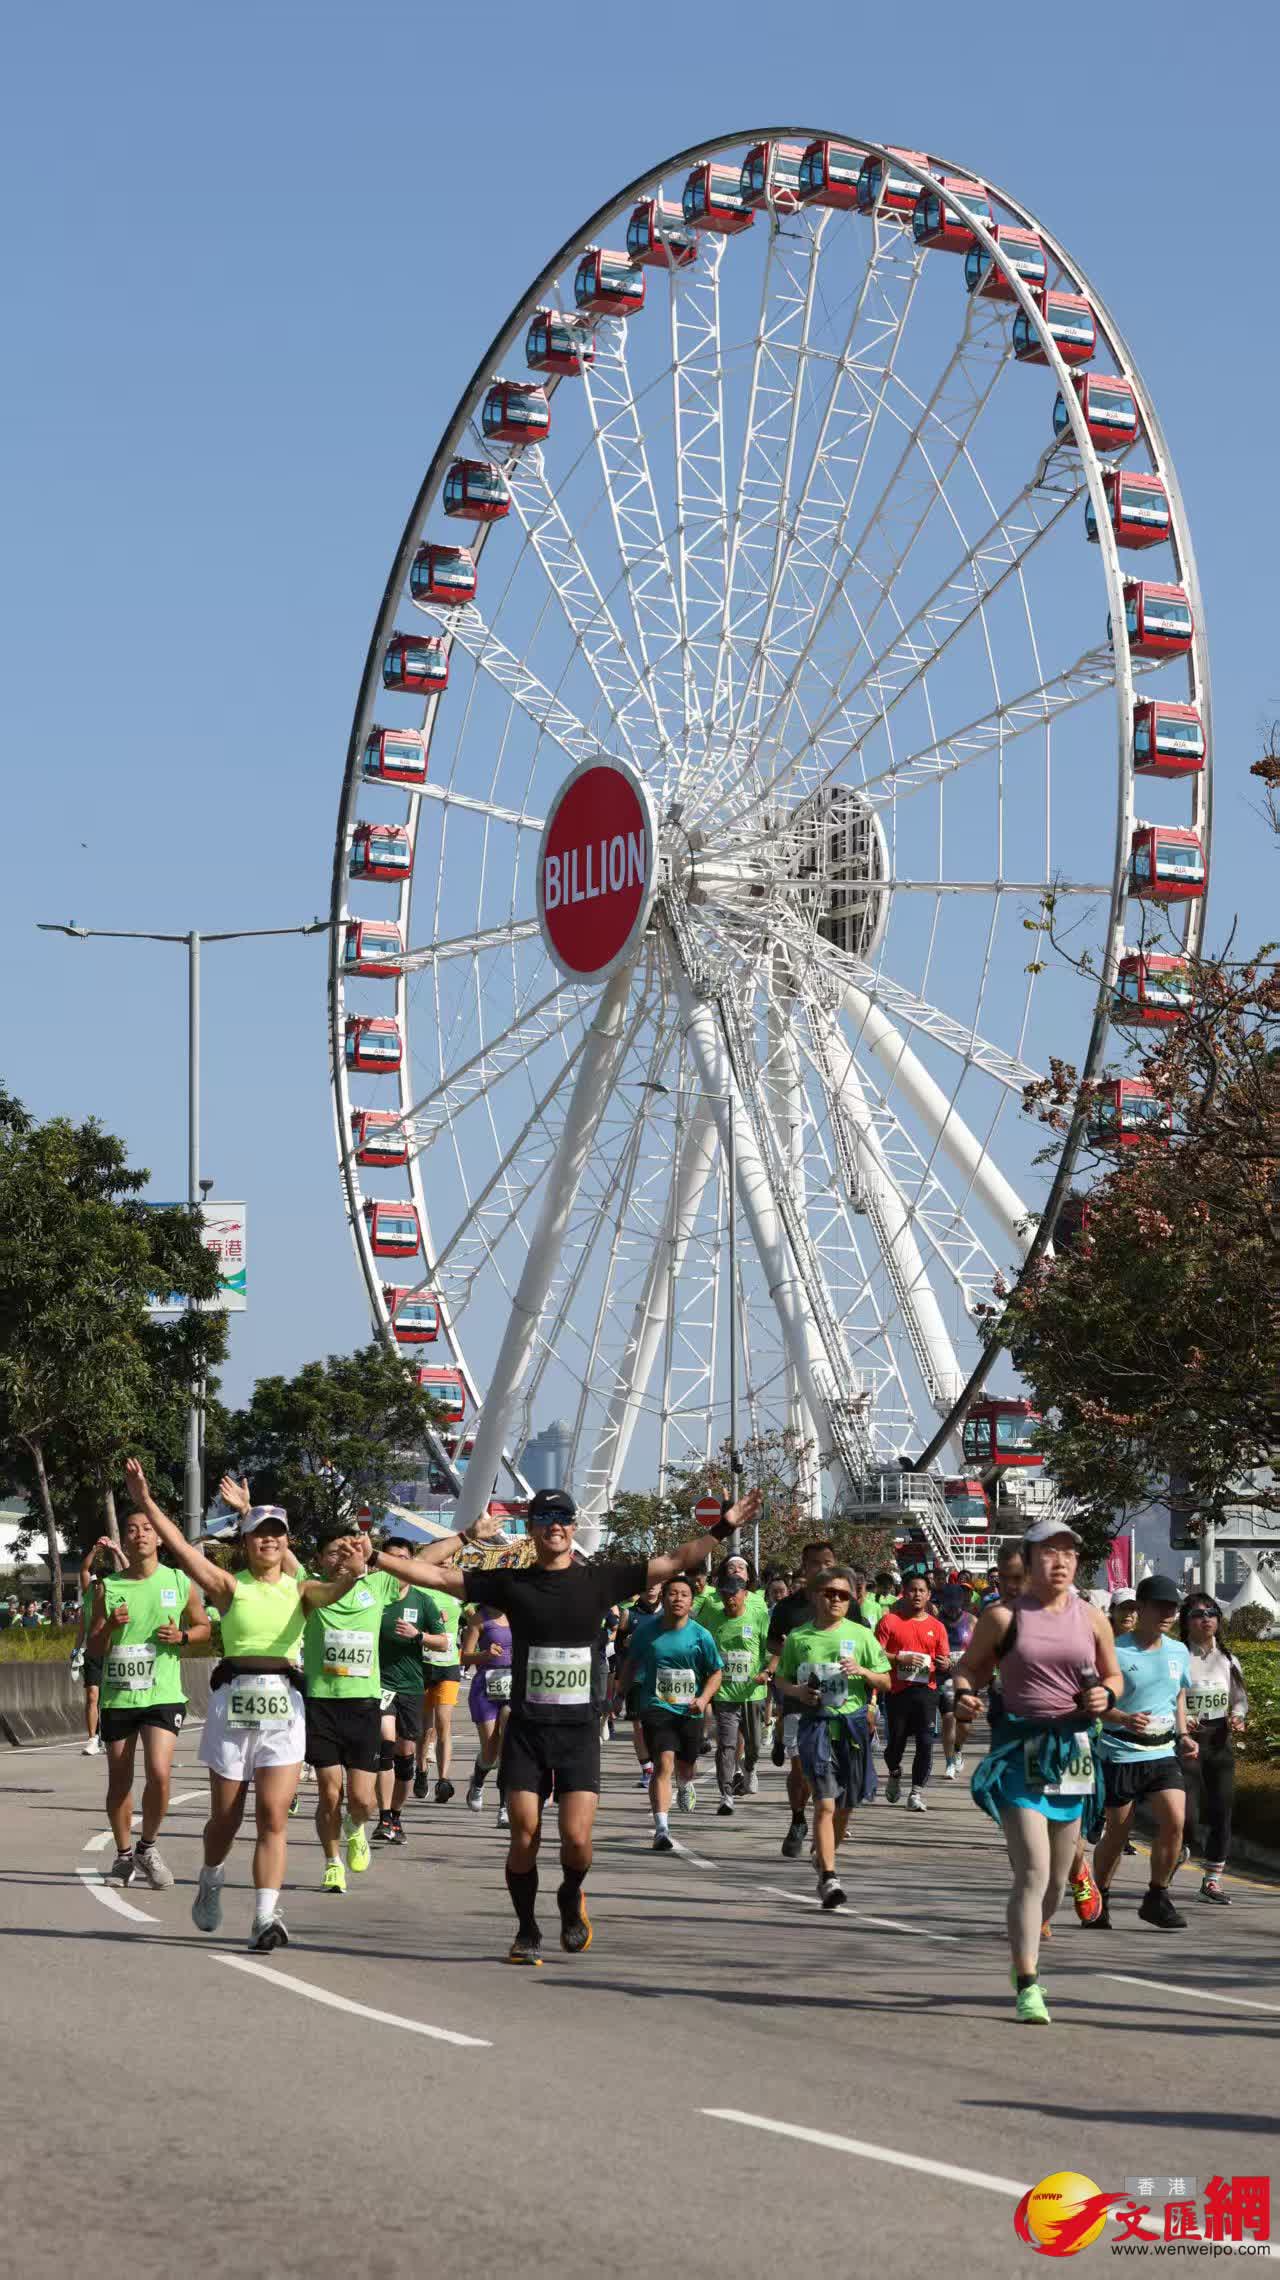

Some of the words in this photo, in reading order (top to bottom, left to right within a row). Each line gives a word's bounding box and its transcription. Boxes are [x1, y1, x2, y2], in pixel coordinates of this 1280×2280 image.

[1161, 620, 1174, 628] AIA
[1174, 740, 1186, 748] AIA
[545, 829, 645, 911] BILLION
[1174, 866, 1186, 874] AIA
[325, 1647, 372, 1664] G4457
[107, 1660, 154, 1678] E0807
[530, 1669, 587, 1689] D5200
[657, 1681, 695, 1693] G4618
[232, 1695, 289, 1715] E4363
[1186, 1692, 1228, 1710] E7566
